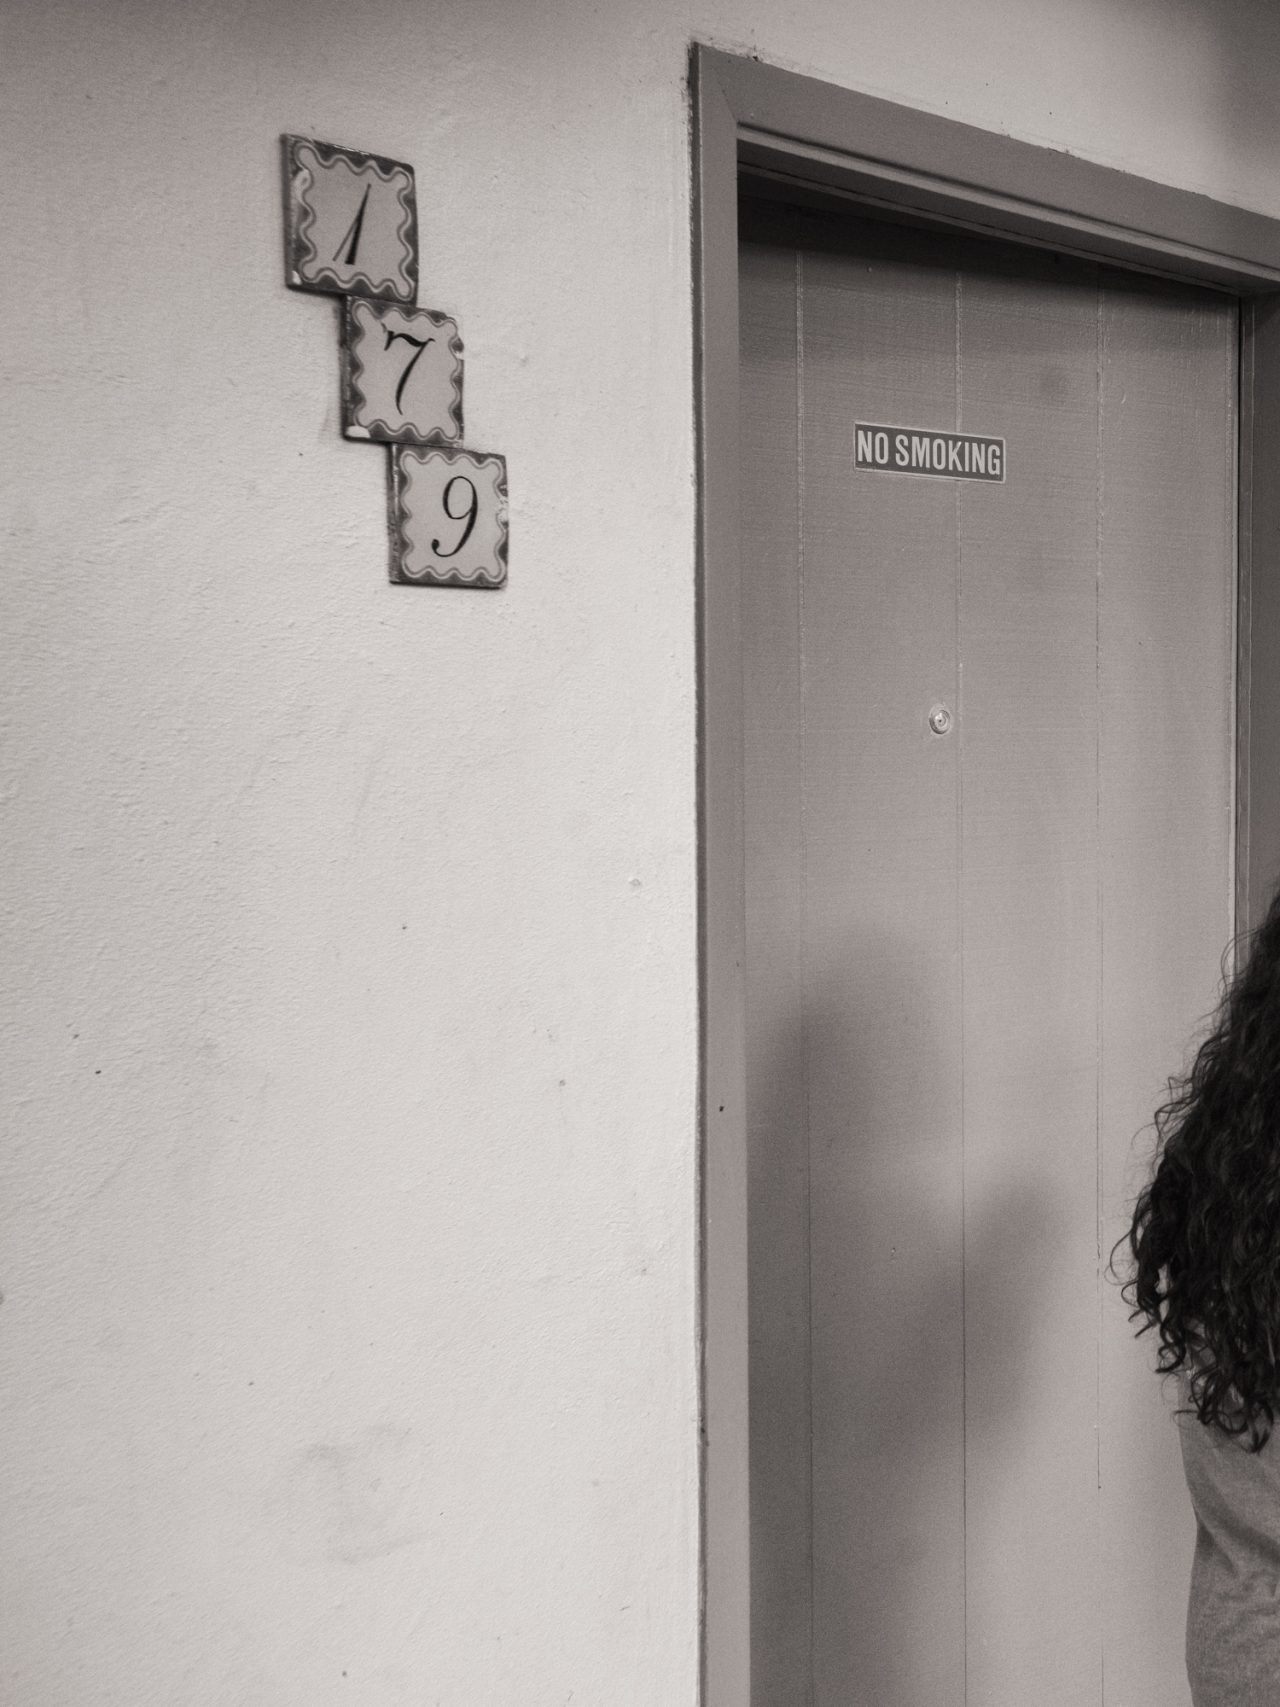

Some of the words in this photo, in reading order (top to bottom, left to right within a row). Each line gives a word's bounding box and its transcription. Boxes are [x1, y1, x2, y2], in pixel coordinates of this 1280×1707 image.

[382, 323, 436, 416] 7
[857, 430, 889, 465] NO
[895, 434, 1001, 476] SMOKING
[430, 475, 479, 558] 9
